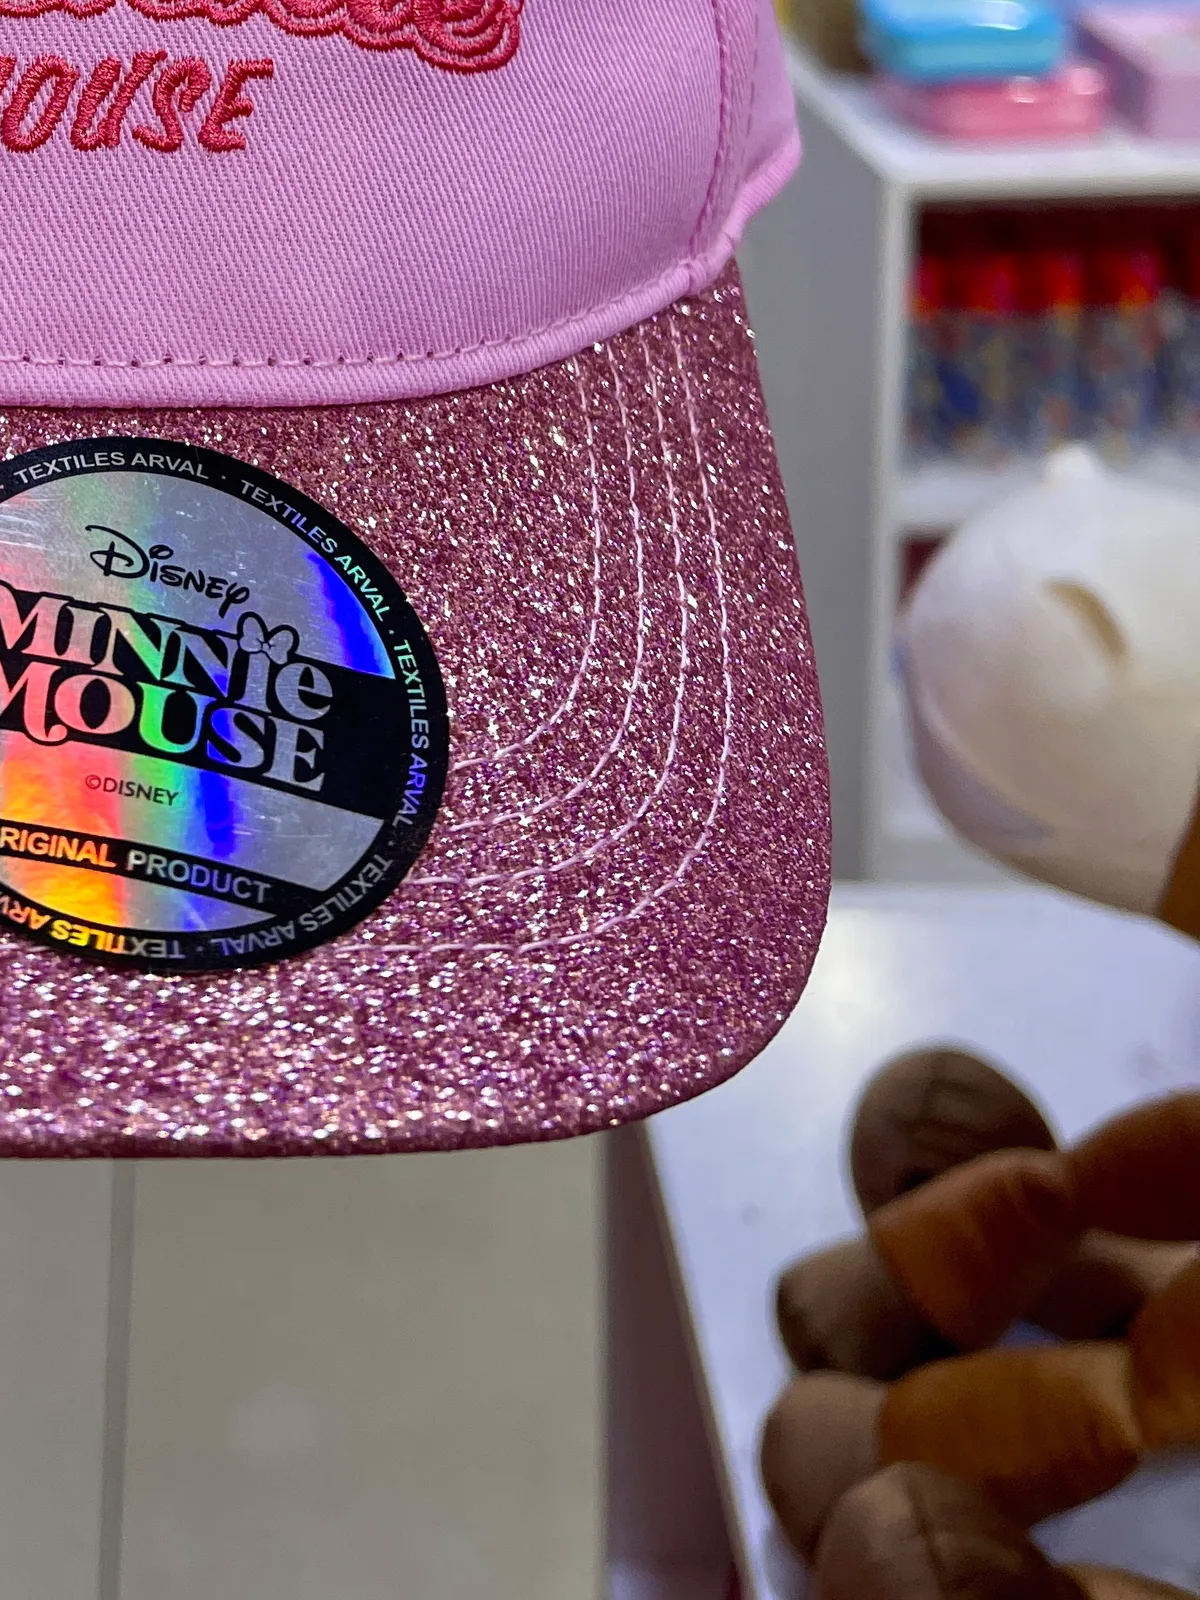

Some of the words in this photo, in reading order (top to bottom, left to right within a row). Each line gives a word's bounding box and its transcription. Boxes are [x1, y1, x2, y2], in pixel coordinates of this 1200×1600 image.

[14, 451, 126, 485] TEXTILES
[130, 452, 210, 480] ARVAL
[240, 480, 339, 554] TEXTILES
[337, 552, 390, 623] ARVAL
[393, 640, 430, 749] TEXTILES
[392, 753, 426, 828] ARVAL
[127, 850, 272, 904] PRODUCT
[300, 854, 393, 934] TEXTILES
[48, 919, 186, 960] TEXTILES
[211, 926, 296, 957] ARVAL
